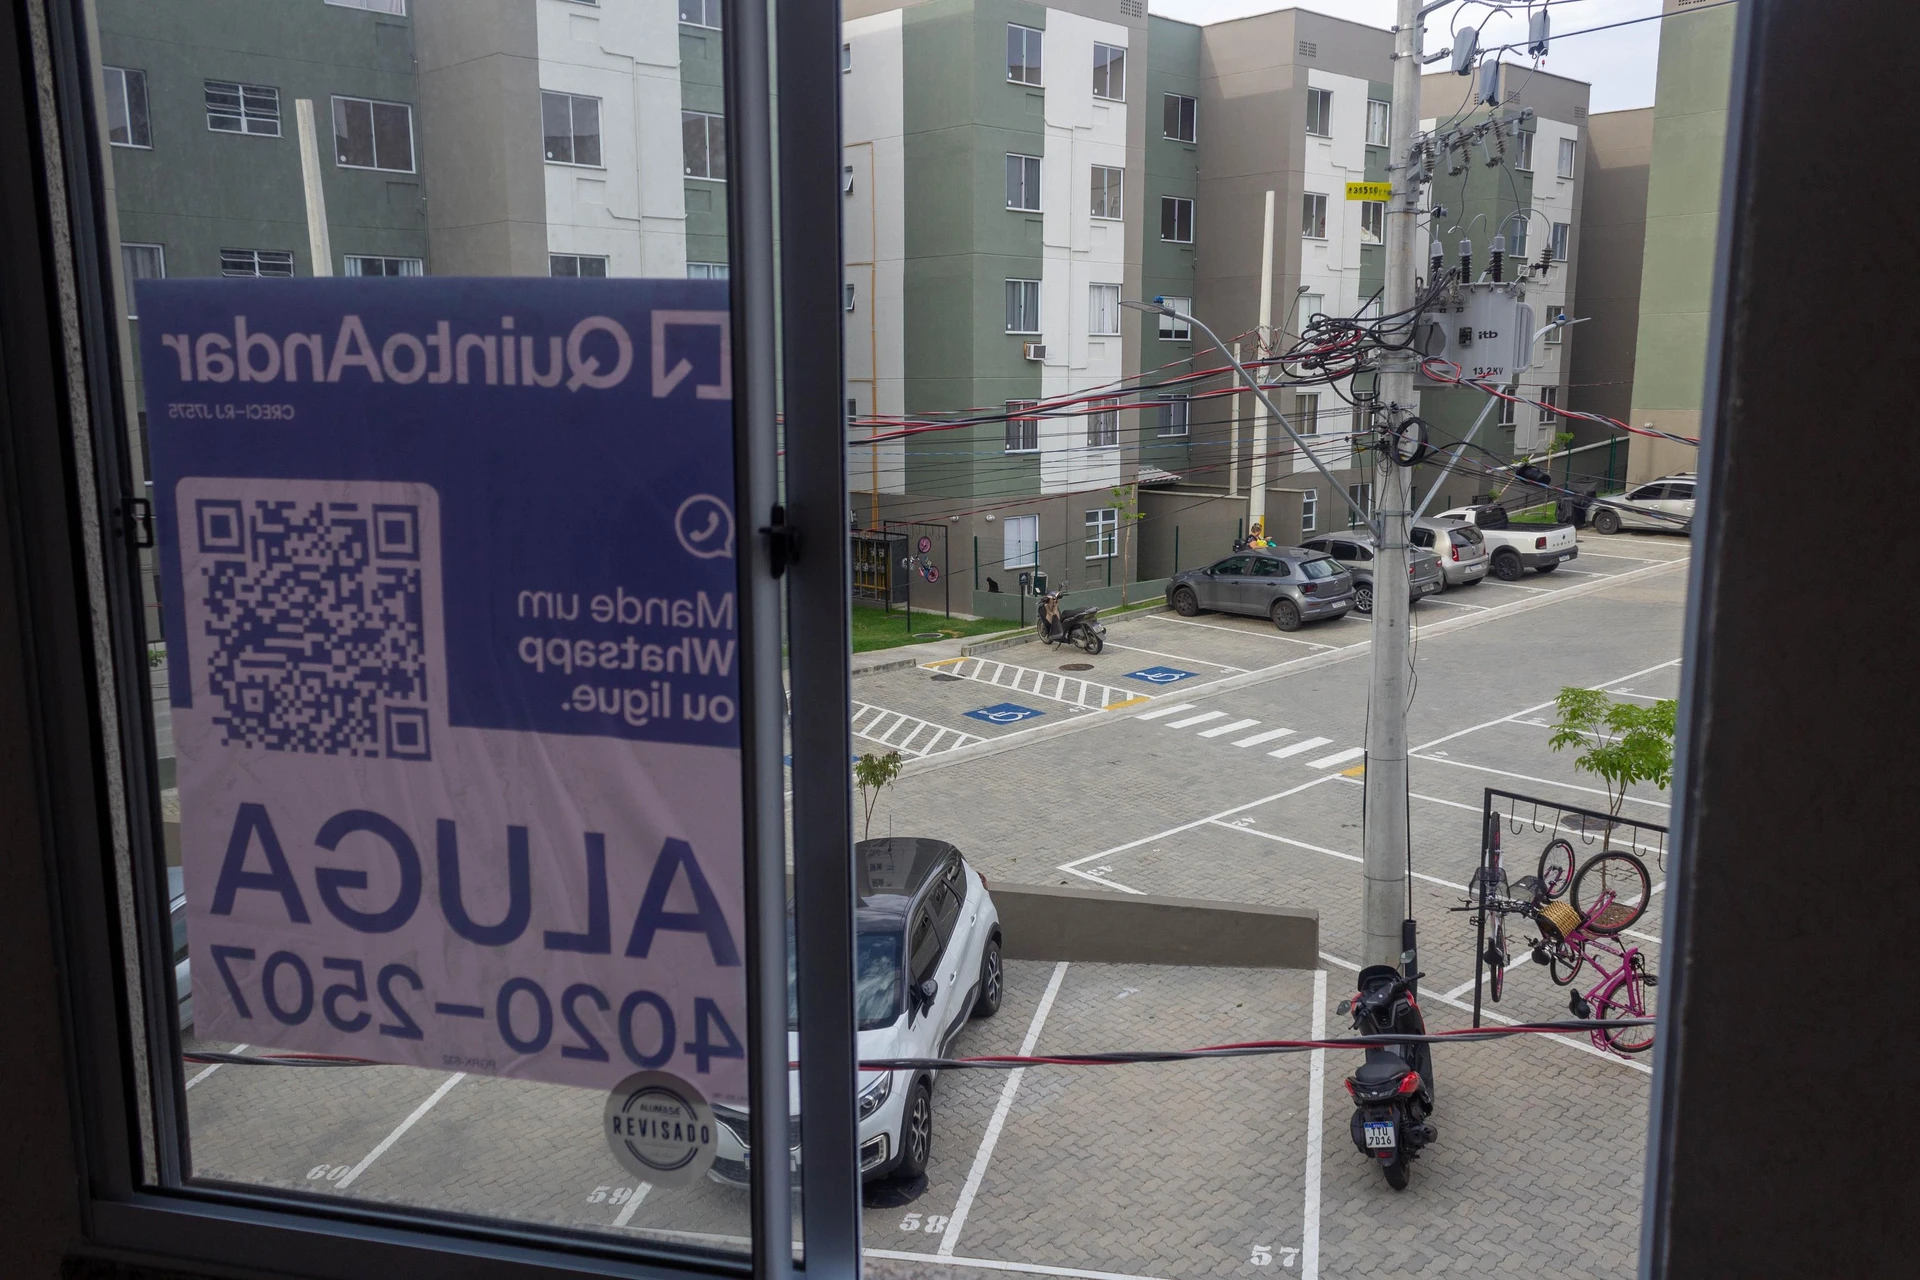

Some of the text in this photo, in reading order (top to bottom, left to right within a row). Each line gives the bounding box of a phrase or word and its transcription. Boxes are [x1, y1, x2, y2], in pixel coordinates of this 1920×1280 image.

[613, 1116, 709, 1144] REVISADO
[306, 1164, 351, 1180] 60
[586, 1186, 633, 1205] 59
[899, 1212, 949, 1233] 58
[1250, 1244, 1300, 1267] 57
